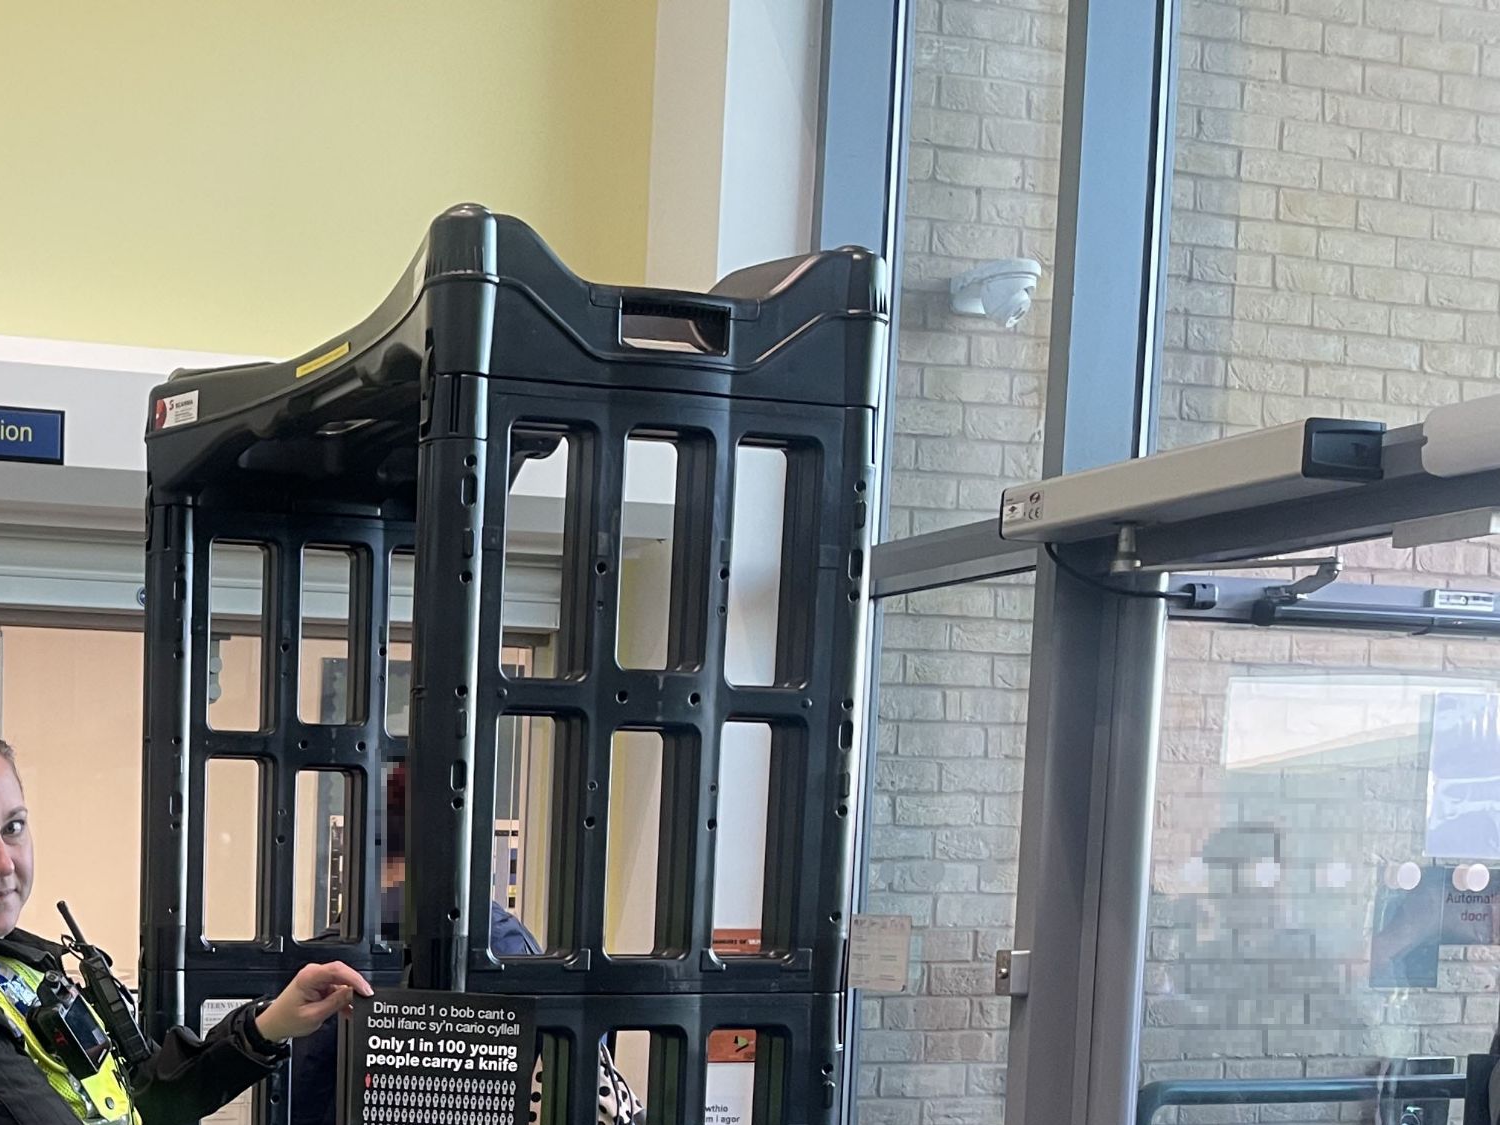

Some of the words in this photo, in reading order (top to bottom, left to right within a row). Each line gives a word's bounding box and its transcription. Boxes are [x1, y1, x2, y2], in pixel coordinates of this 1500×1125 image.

[1461, 910, 1488, 922] door
[374, 1002, 398, 1014] Dim
[402, 1004, 426, 1016] ond
[429, 1005, 434, 1016] 1
[440, 1008, 448, 1016] o
[450, 1006, 474, 1018] bob
[478, 1008, 504, 1020] cant
[507, 1012, 516, 1020] o
[368, 1016, 394, 1028] bobl
[398, 1018, 426, 1030] ifanc
[456, 1022, 485, 1034] cario
[487, 1023, 520, 1037] cyllell
[368, 1036, 404, 1053] Only
[408, 1038, 415, 1051] 1
[419, 1038, 434, 1052] in
[437, 1040, 466, 1054] 100
[470, 1044, 518, 1060] young
[366, 1053, 420, 1068] people
[422, 1056, 462, 1072] carry
[464, 1059, 474, 1070] a
[478, 1056, 518, 1072] knife
[720, 1116, 740, 1124] agor
